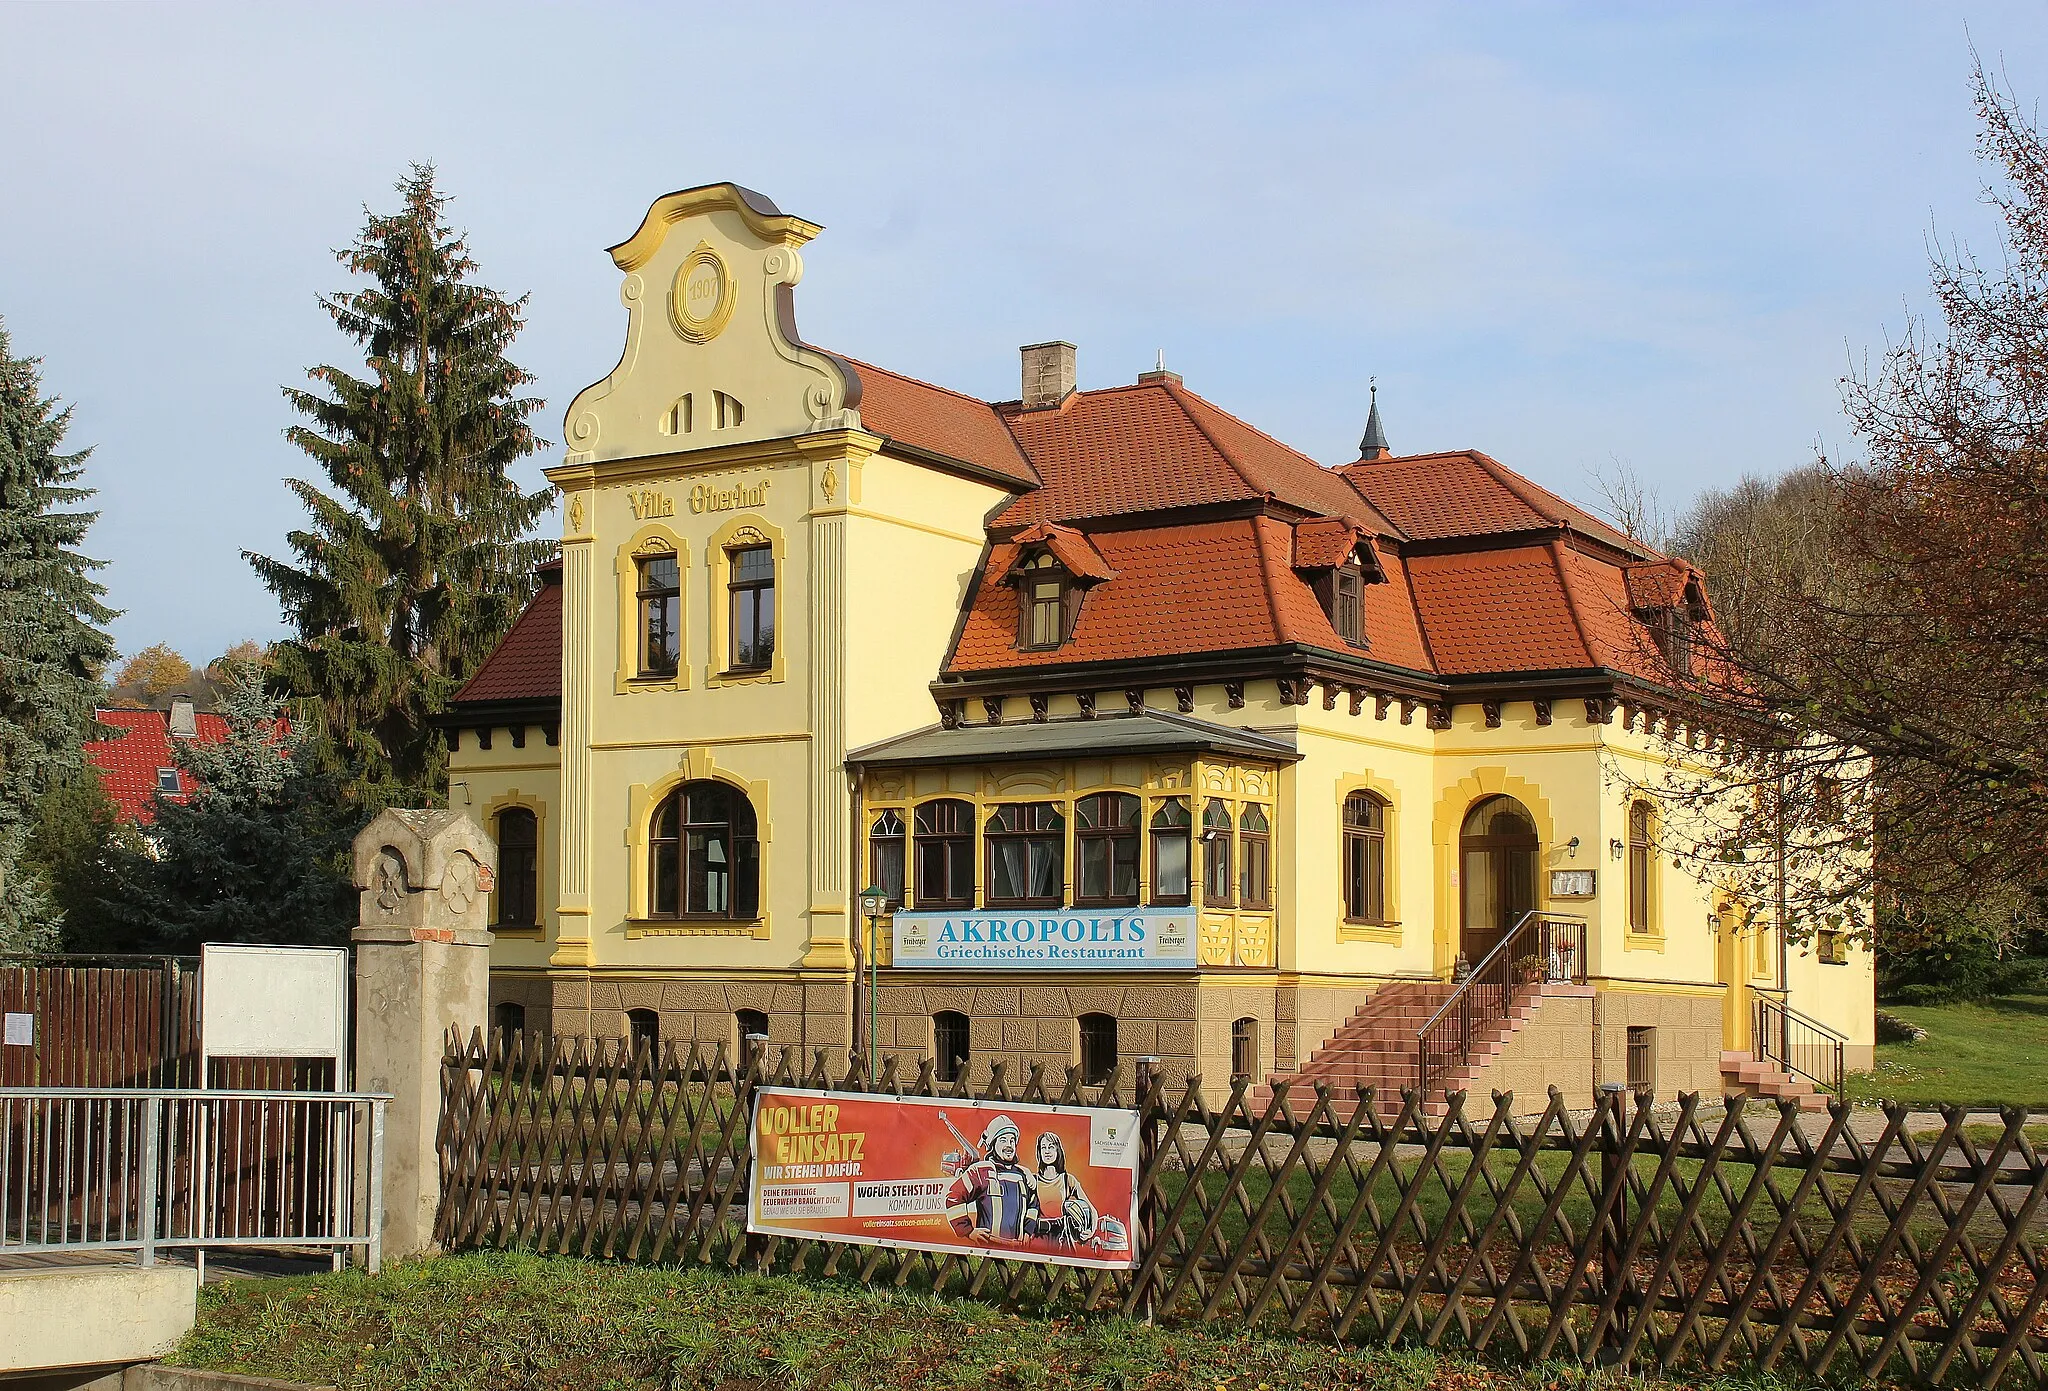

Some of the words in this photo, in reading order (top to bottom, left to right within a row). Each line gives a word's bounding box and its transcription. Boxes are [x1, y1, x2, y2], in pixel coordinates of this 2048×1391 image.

[690, 276, 718, 300] 1907
[627, 489, 675, 520] Villa
[687, 479, 771, 515] Oberhof
[936, 918, 1146, 943] AKROPOLIS
[1158, 935, 1186, 946] Freiberger
[936, 945, 1044, 959] Griechisches
[1047, 944, 1145, 958] Restaurant
[760, 1104, 839, 1135] VOLLER
[776, 1132, 865, 1163] EINSATZ
[764, 1165, 783, 1179] WIR
[784, 1164, 823, 1179] STEHEN
[825, 1160, 863, 1177] DAFÜR.
[763, 1188, 780, 1197] DEINE
[781, 1187, 817, 1197] FREIWILLIGE
[857, 1184, 890, 1198] WOFÜR
[891, 1184, 924, 1197] STEHST
[925, 1183, 944, 1196] DU?
[763, 1197, 797, 1206] FEUERWEHR
[798, 1196, 825, 1205] BRAUCHT
[888, 1199, 913, 1211] KOMM
[914, 1198, 924, 1210] ZU
[925, 1198, 943, 1210] UNS.
